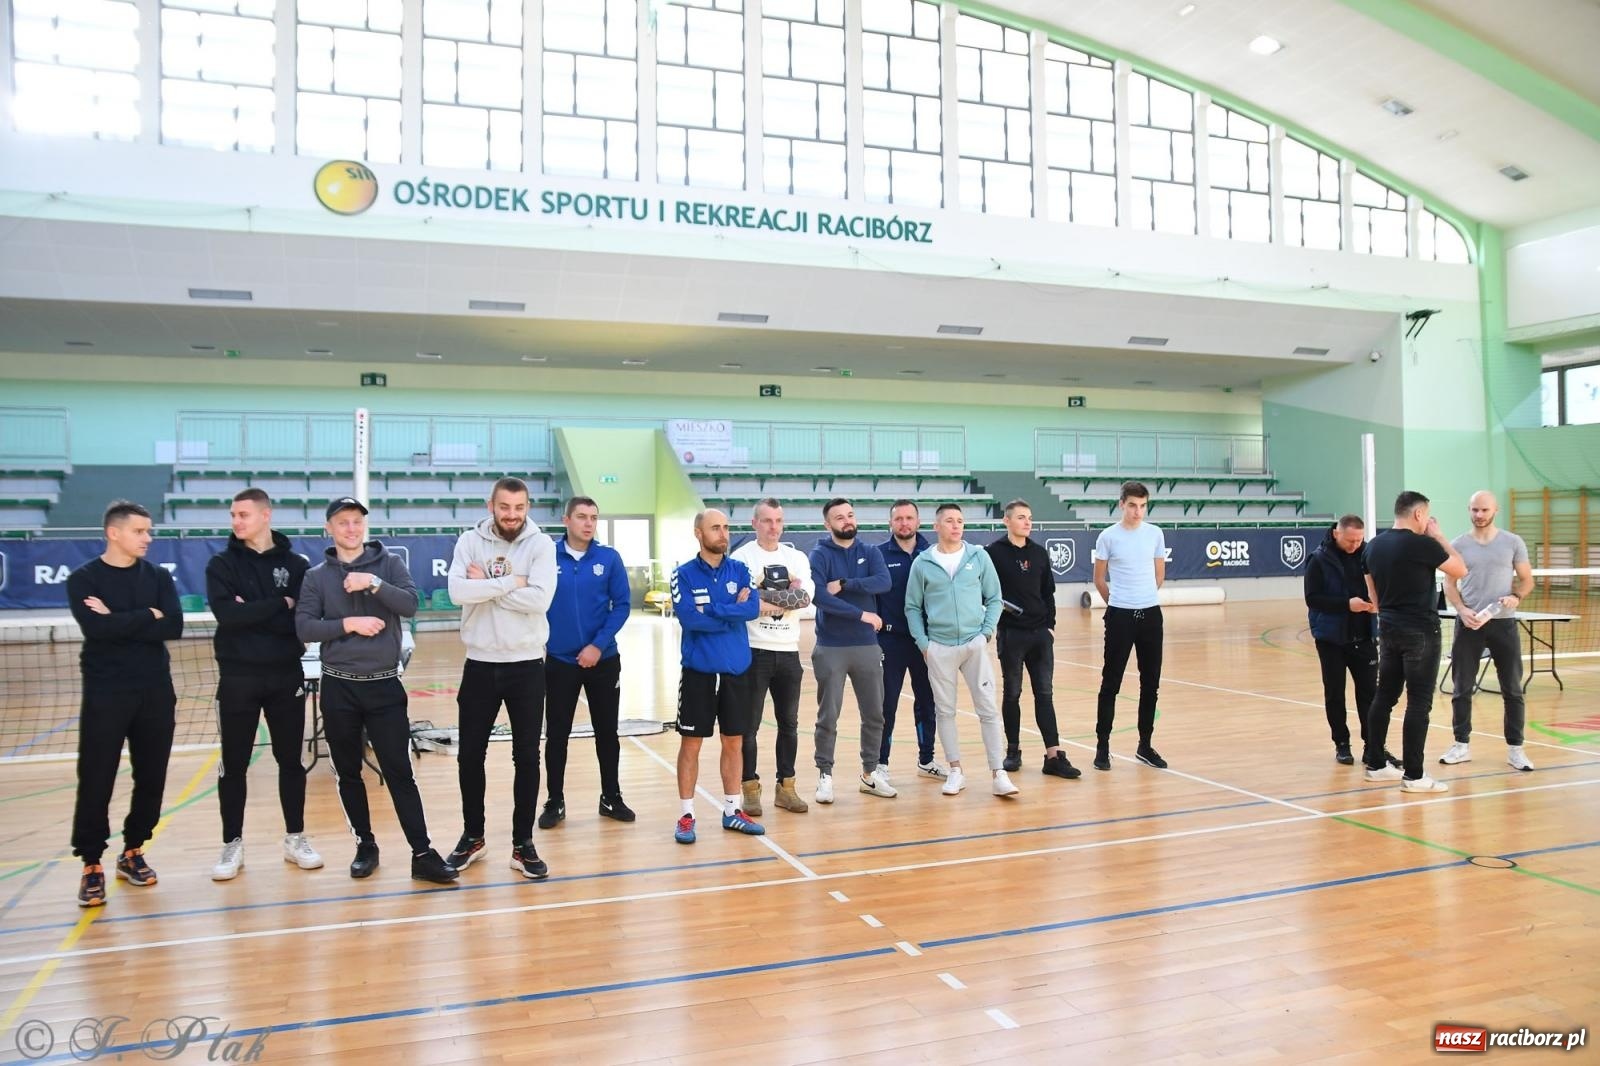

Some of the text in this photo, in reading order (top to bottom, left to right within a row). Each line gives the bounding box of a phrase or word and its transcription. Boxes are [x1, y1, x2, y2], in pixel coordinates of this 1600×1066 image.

[393, 176, 933, 243] OŚRODEK SPORTU I REKREACJI RACIBÓRZ
[762, 388, 771, 396] C
[1070, 399, 1081, 407] D
[676, 422, 726, 433] MIESZKO
[1206, 540, 1250, 560] OSiR
